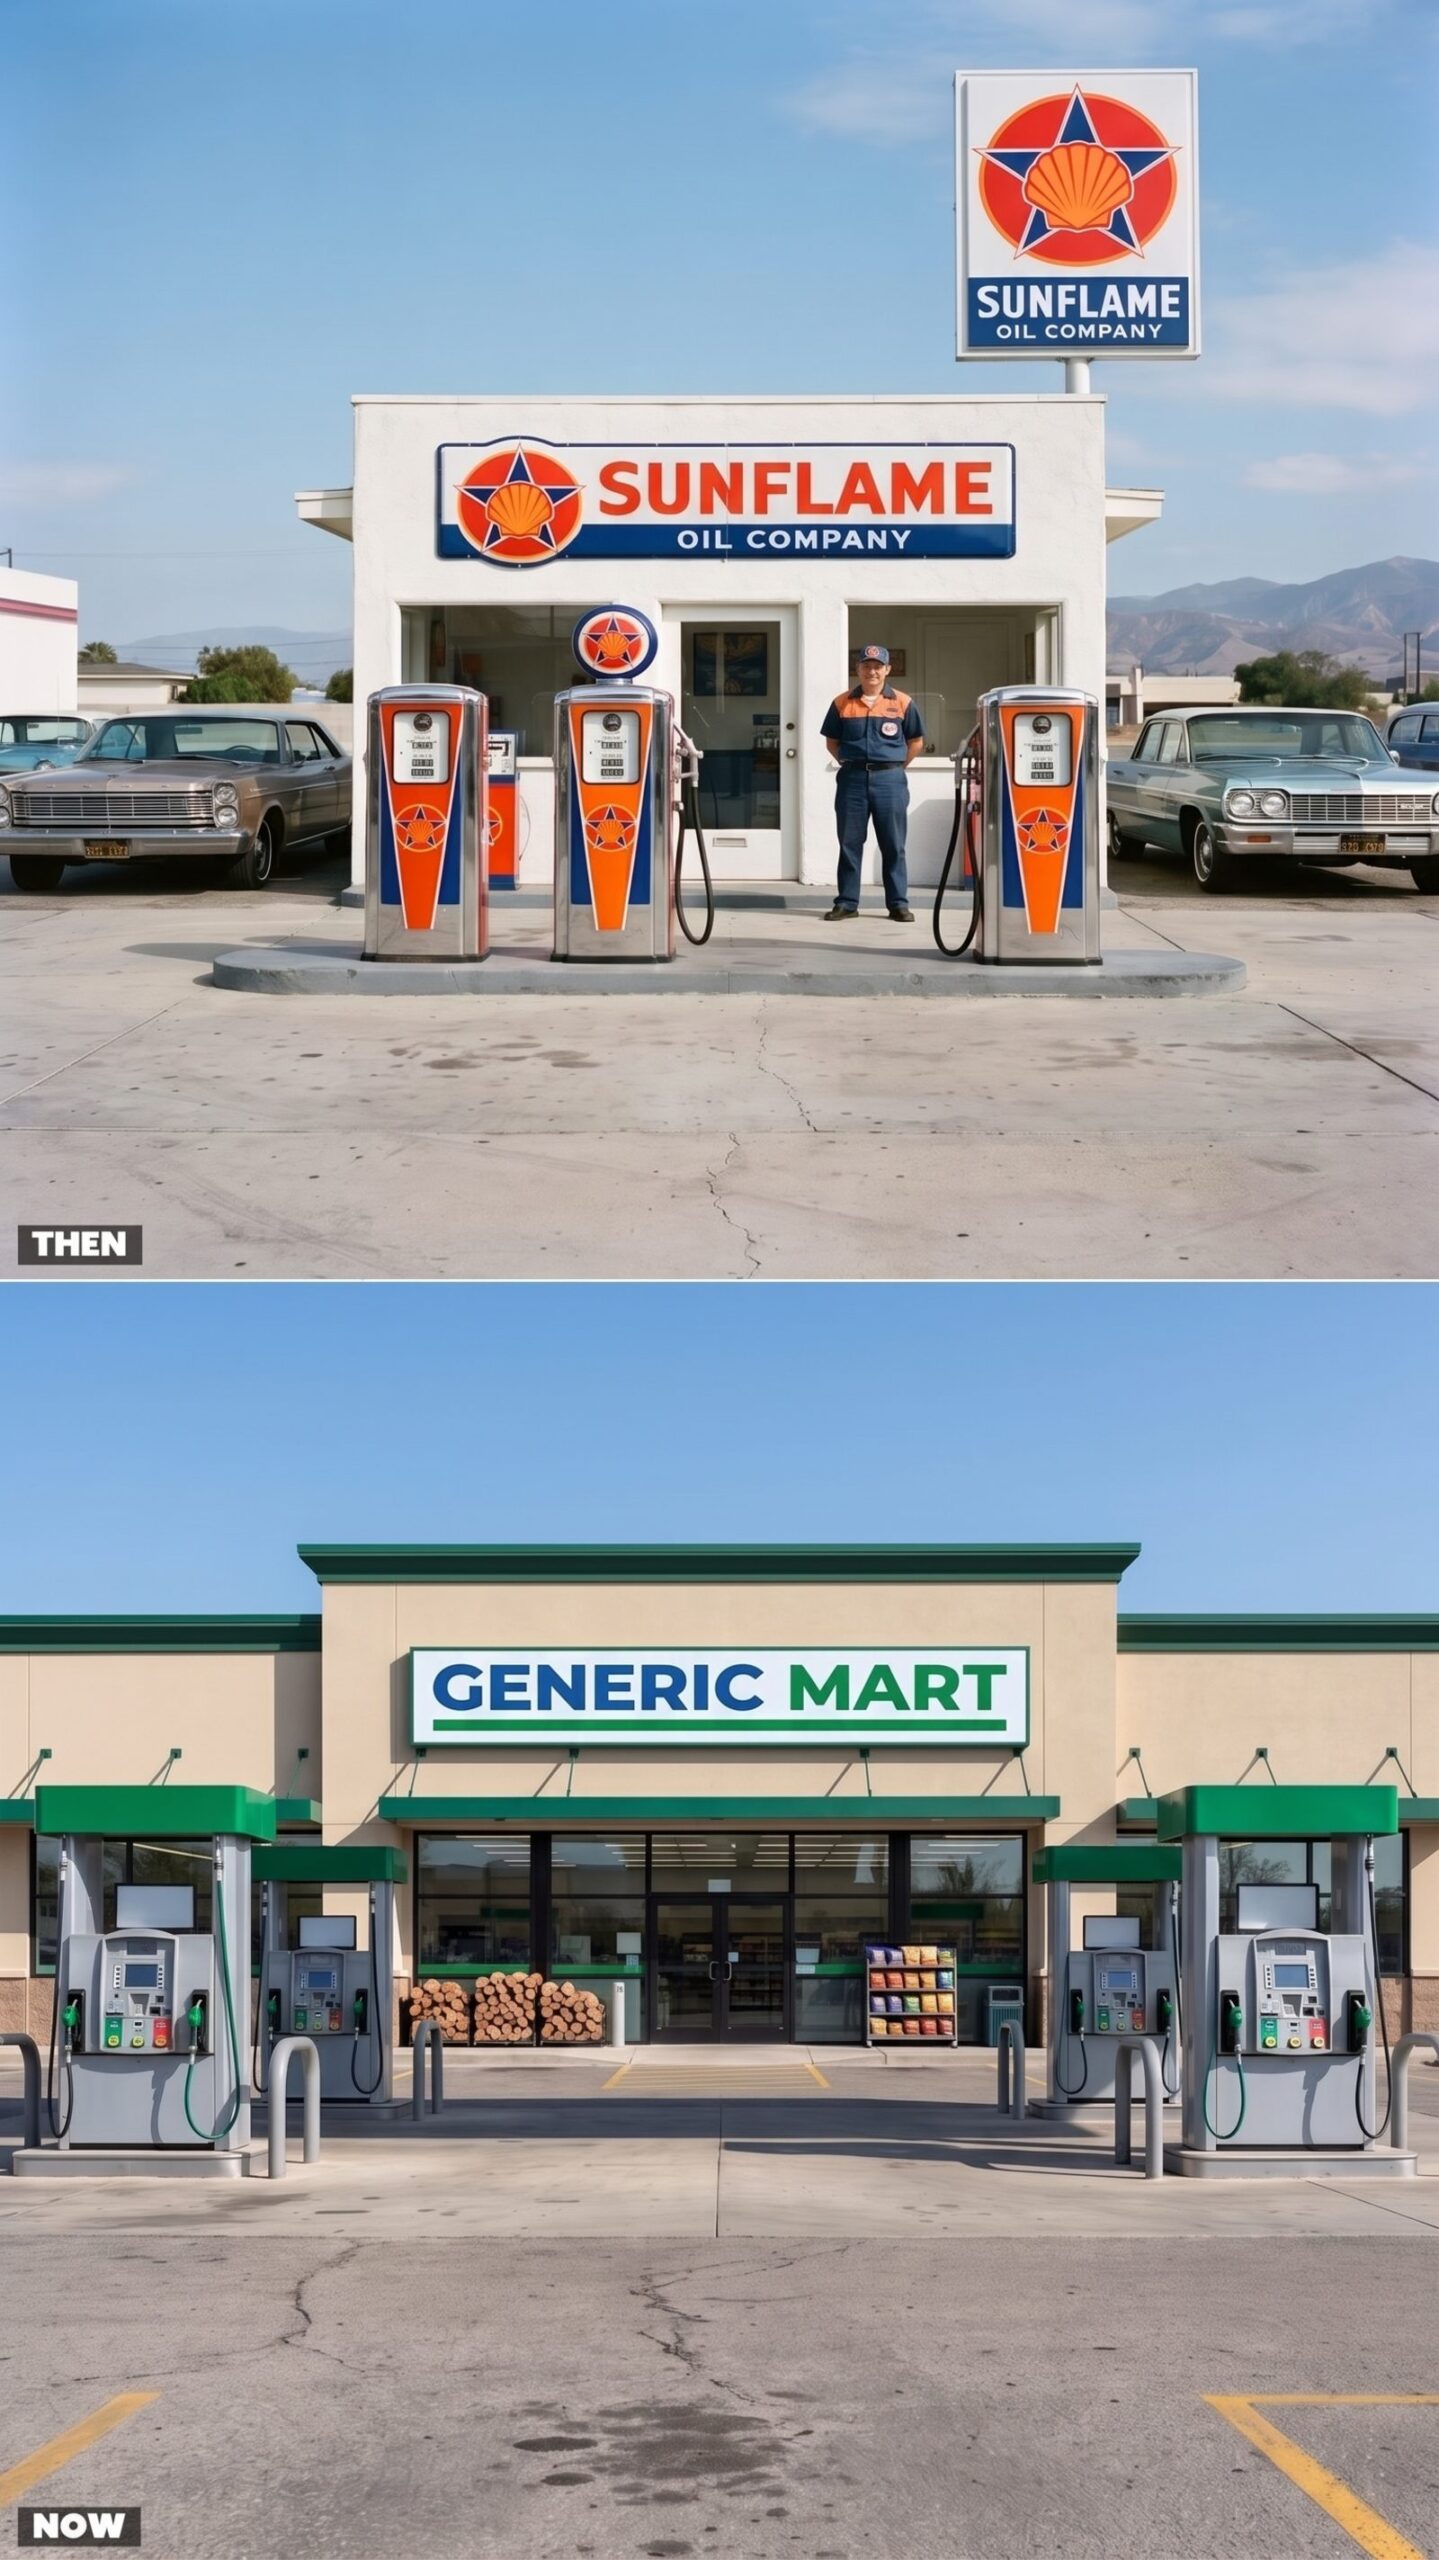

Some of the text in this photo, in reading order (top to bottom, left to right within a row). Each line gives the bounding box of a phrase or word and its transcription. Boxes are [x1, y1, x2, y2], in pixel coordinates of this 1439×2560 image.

[977, 284, 1180, 319] SUNFLAME
[996, 324, 1162, 339] OIL COMPANY
[599, 461, 993, 516] SUNFLAME
[677, 530, 912, 550] OIL COMPANY
[432, 1663, 1008, 1712] GENERIC MART
